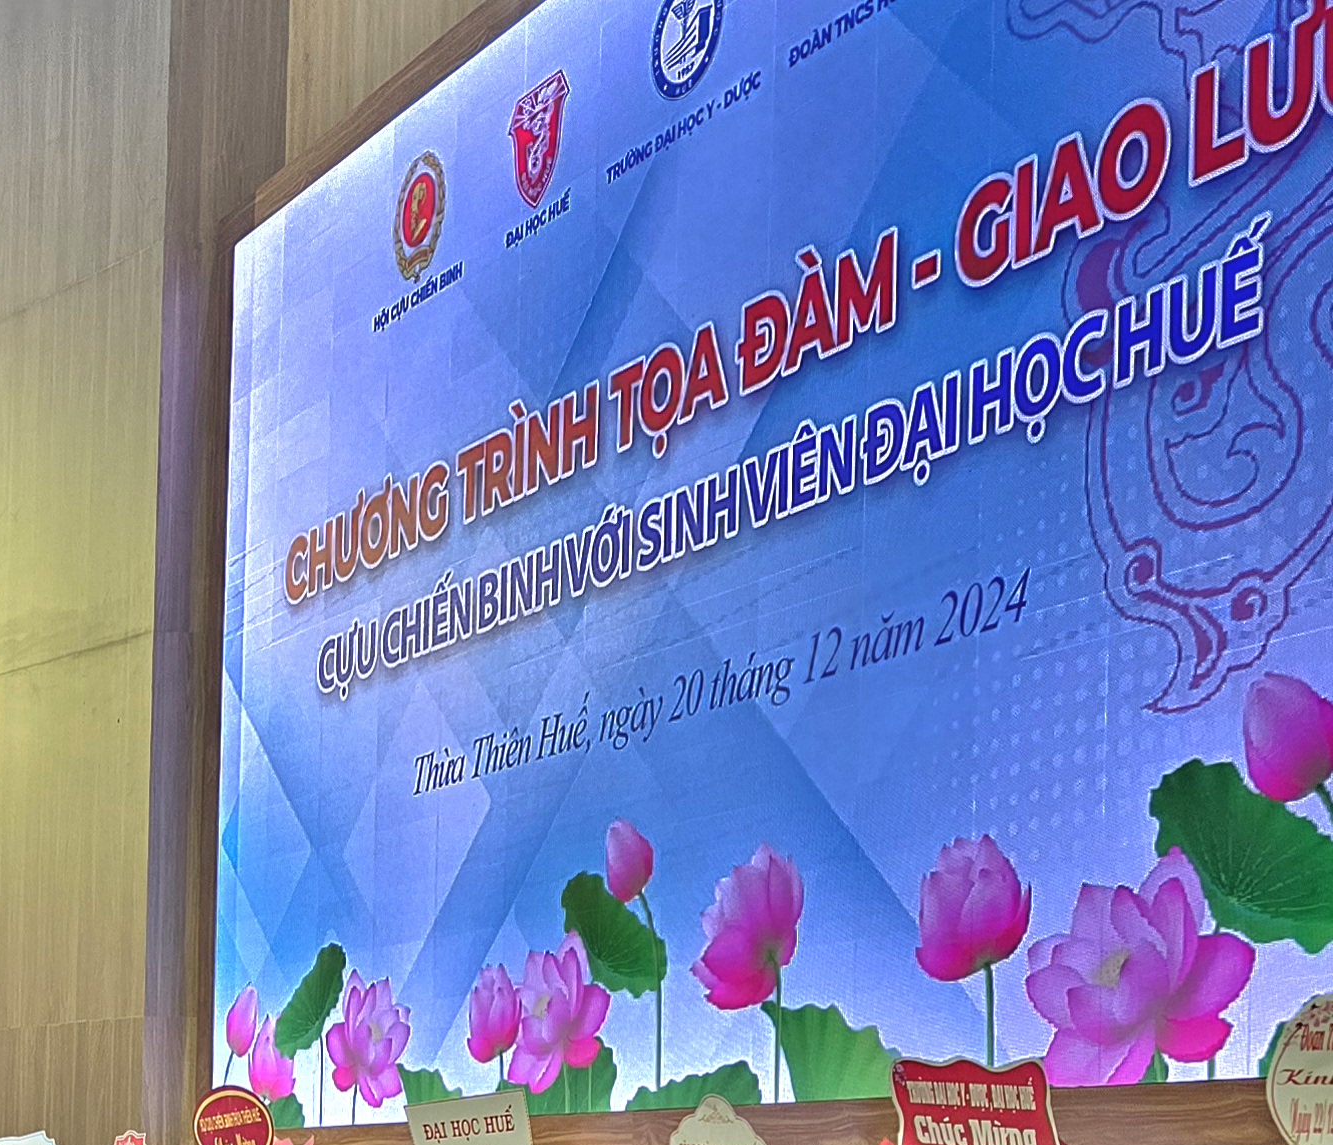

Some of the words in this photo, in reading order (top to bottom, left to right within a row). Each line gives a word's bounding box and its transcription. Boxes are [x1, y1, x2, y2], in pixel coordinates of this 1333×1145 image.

[788, 22, 832, 67] ĐOÀN
[834, 0, 874, 38] TNCS
[606, 141, 652, 184] TRƯỜNG
[654, 128, 676, 152] ĐẠI
[677, 107, 704, 136] HỌC
[705, 101, 715, 120] Y
[724, 71, 762, 109] DƯỢC
[505, 227, 523, 248] ĐẠI
[526, 212, 546, 236] HỌC
[547, 187, 571, 223] HUẾ
[285, 460, 449, 604] CHƯƠNG
[457, 384, 600, 525] TRÌNH
[608, 323, 727, 457] TỌA
[736, 226, 898, 397] ĐÀM
[911, 249, 941, 290] -
[955, 97, 1171, 287] GIAO
[1188, 0, 1333, 188] LƯ
[373, 308, 389, 332] HỘI
[390, 296, 410, 320] CỰU
[410, 276, 438, 308] CHIẾN
[439, 261, 463, 291] BINH
[317, 620, 378, 700] CỰU
[381, 570, 472, 668] CHIẾN
[477, 541, 561, 634] BINH
[565, 503, 633, 598] VỚI
[637, 464, 741, 572] SINH
[741, 413, 857, 528] VIÊN
[860, 370, 961, 486] ĐẠI
[968, 308, 1108, 444] HỌC
[1112, 211, 1273, 390] HUẾ
[412, 747, 465, 797] Thừa
[472, 727, 533, 780] Thiên
[536, 691, 592, 761] Huế,
[598, 686, 664, 753] ngày
[668, 675, 704, 725] 20
[709, 650, 795, 711] tháng
[803, 626, 842, 685] 12
[849, 611, 926, 672] năm
[933, 567, 1032, 648] 2024
[423, 1122, 447, 1144] ĐẠI
[450, 1118, 480, 1141] HỌC
[484, 1104, 515, 1134] HUẾ
